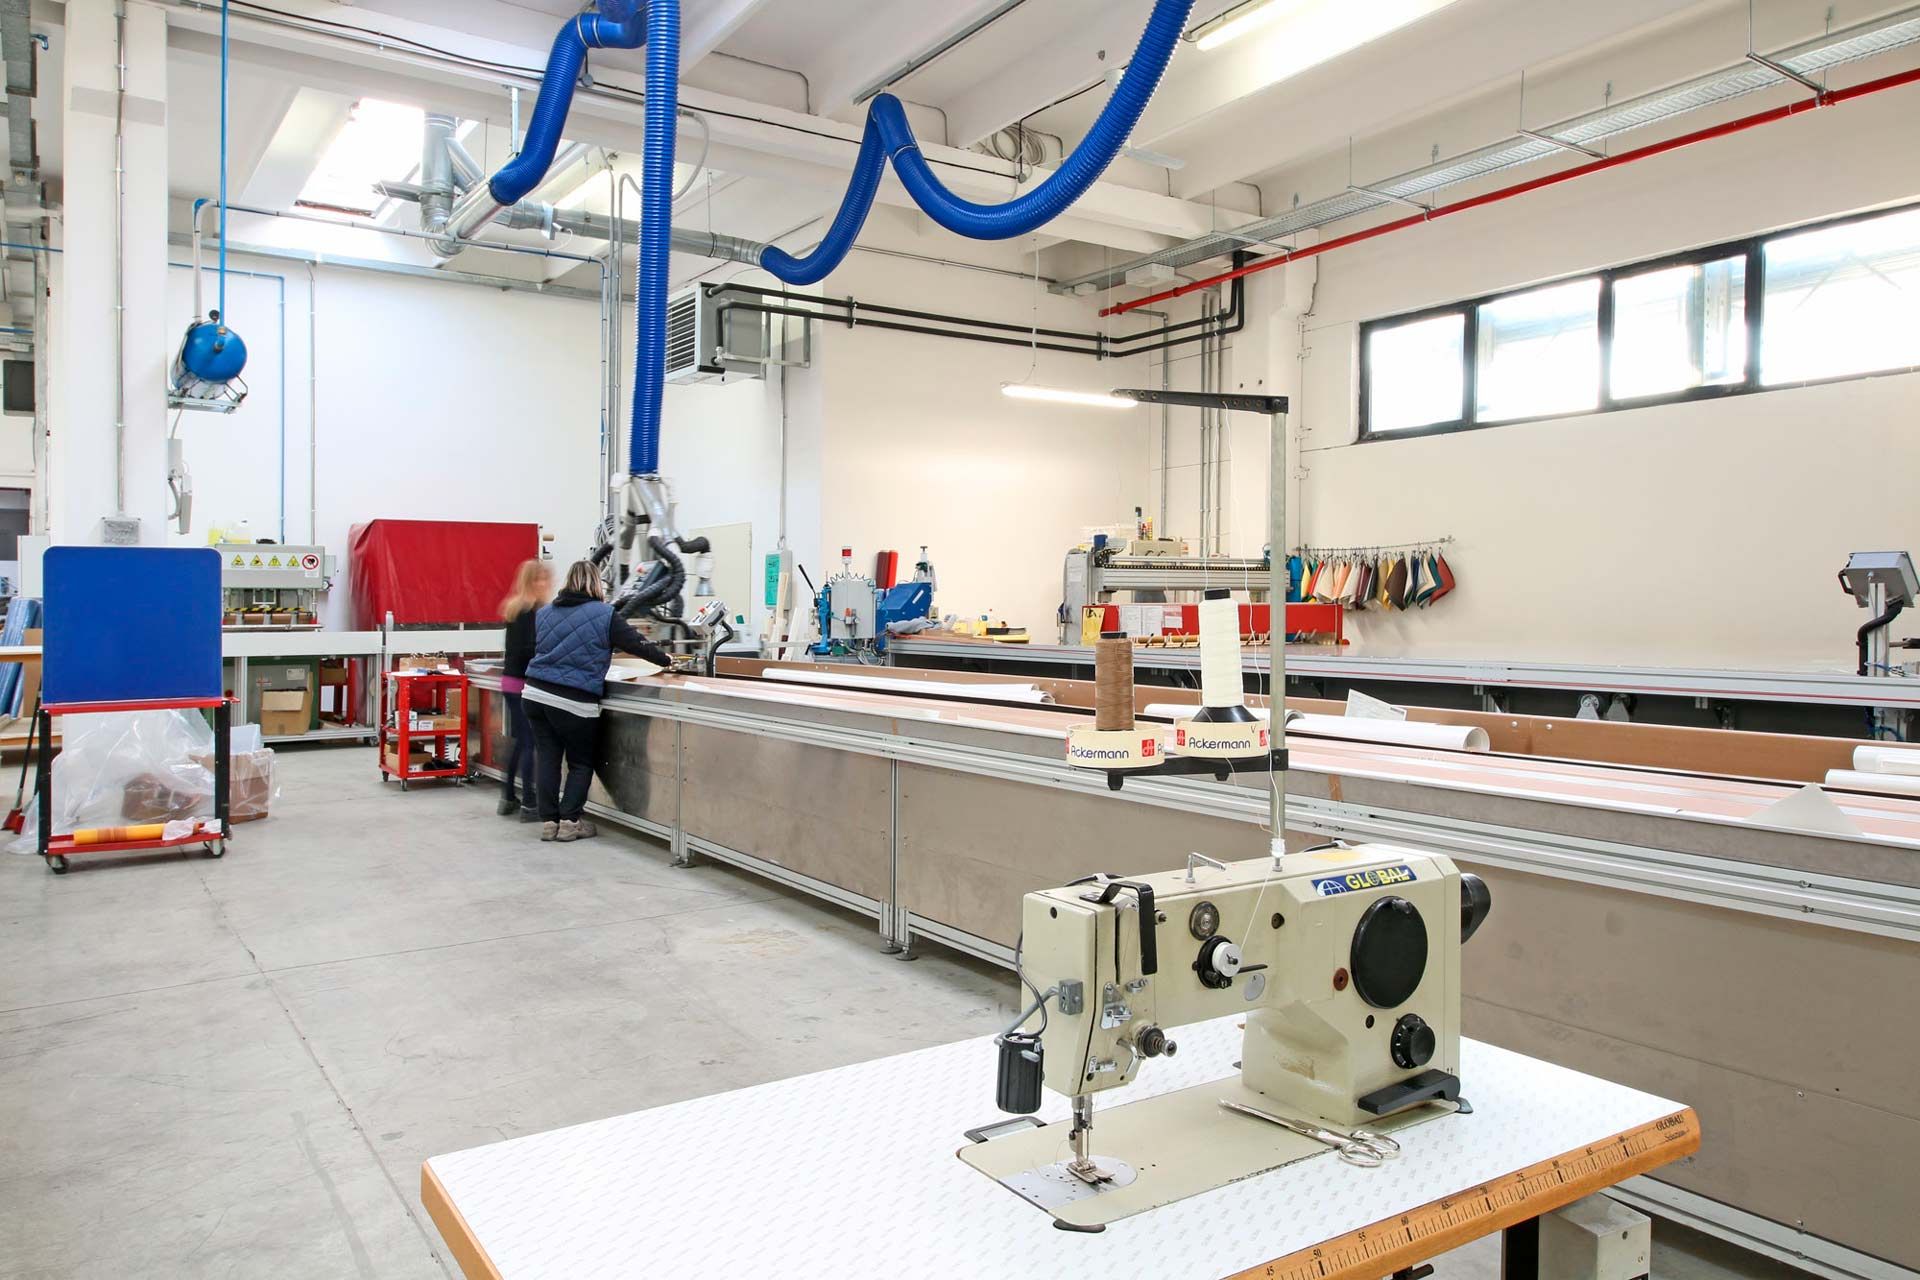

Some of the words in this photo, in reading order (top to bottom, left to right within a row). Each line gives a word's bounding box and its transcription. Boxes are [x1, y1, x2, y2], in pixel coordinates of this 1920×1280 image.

[1188, 736, 1250, 749] Ackermann
[1071, 745, 1129, 759] Ackermann
[1345, 868, 1410, 889] GLOBAL
[1656, 1114, 1684, 1131] GLOBAL
[1266, 1265, 1275, 1276] 45
[1313, 1248, 1322, 1260] 50
[1358, 1231, 1367, 1242] 55
[1401, 1215, 1409, 1226] 60
